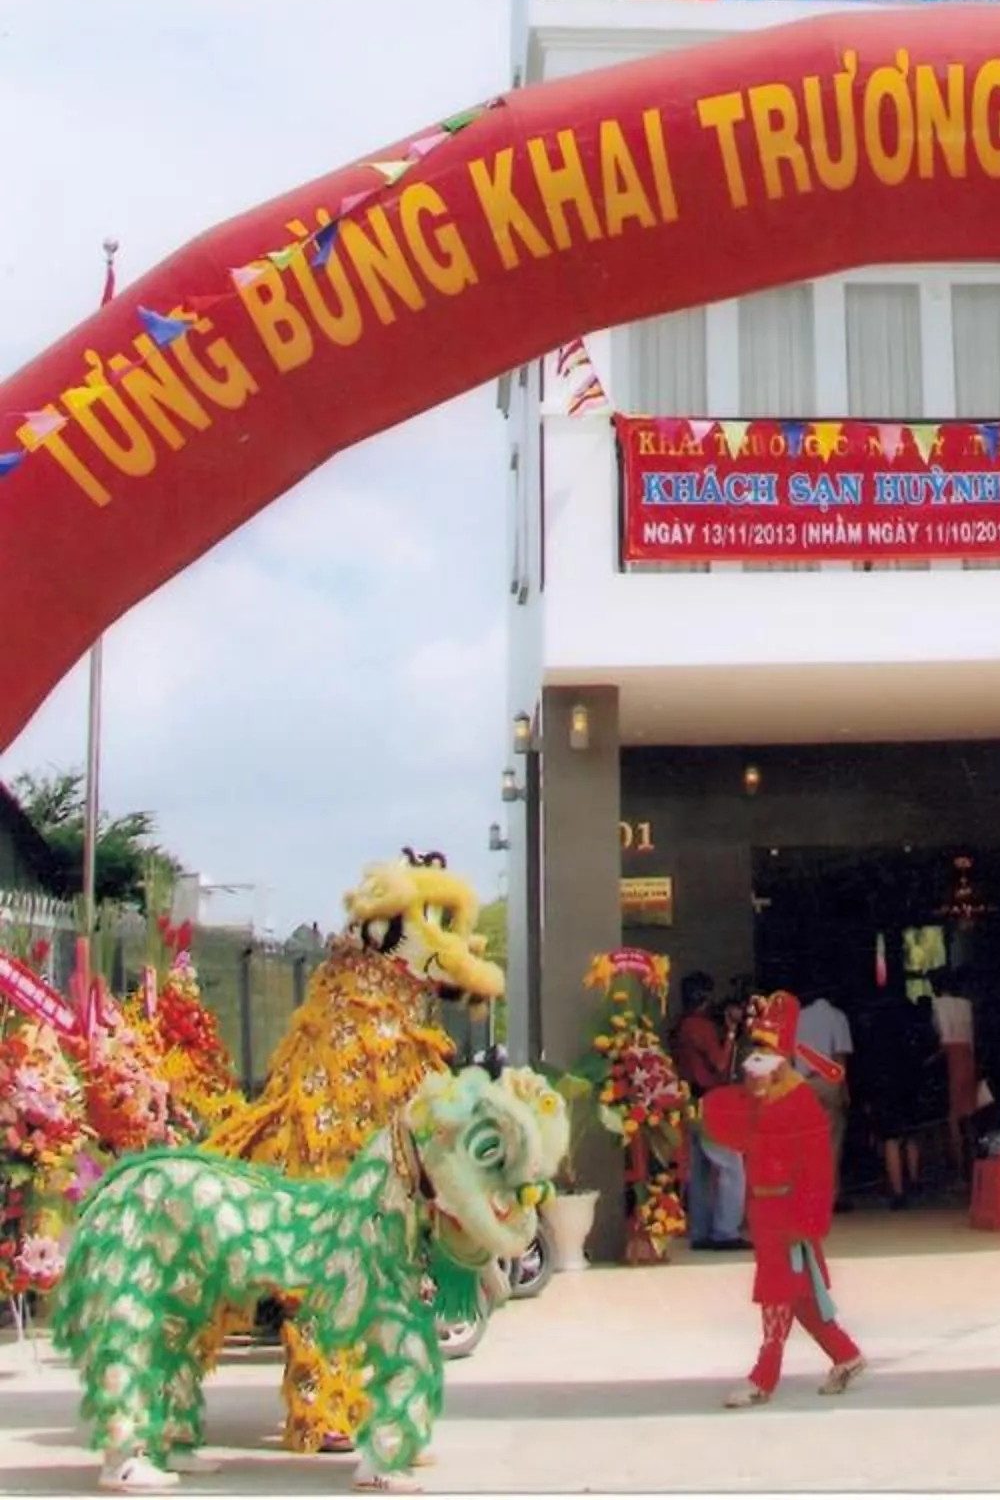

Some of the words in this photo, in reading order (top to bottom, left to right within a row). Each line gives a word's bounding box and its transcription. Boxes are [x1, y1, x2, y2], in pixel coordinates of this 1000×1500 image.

[469, 108, 678, 269] KHAI
[642, 464, 778, 506] KHÁCH
[789, 472, 864, 513] SẠN
[643, 517, 696, 545] NGÀY
[702, 522, 797, 547] 13/11/2013
[868, 516, 920, 545] NGÀY
